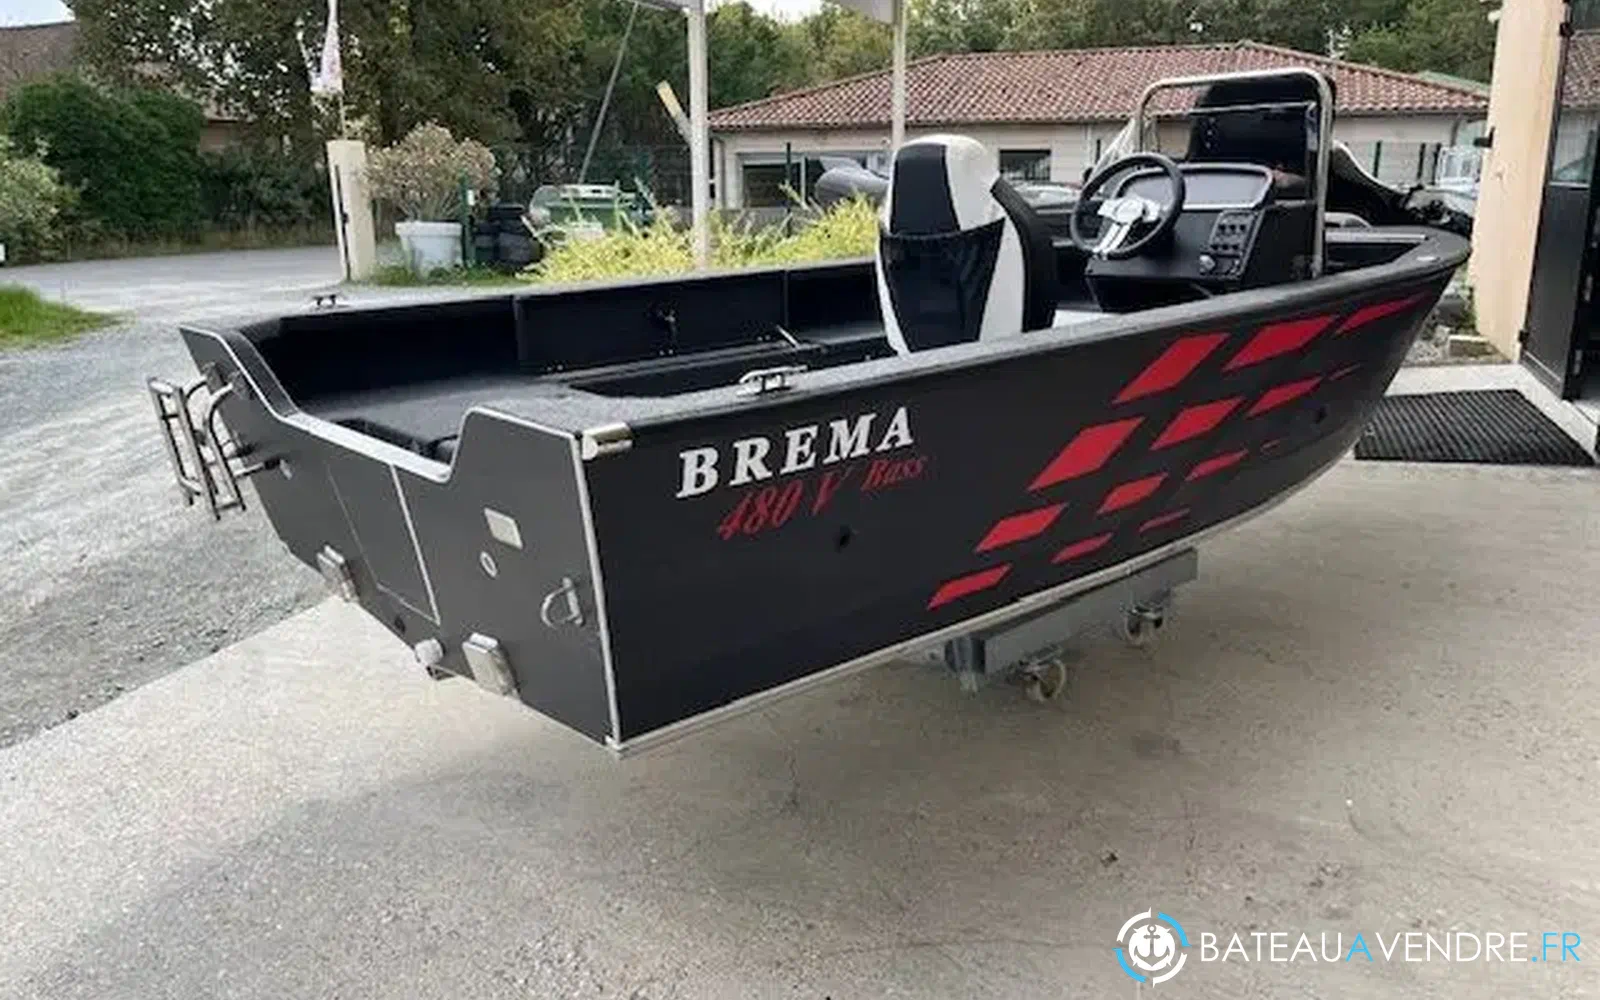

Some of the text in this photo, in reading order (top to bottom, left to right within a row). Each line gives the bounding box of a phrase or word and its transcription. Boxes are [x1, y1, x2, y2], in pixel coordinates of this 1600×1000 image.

[676, 406, 914, 498] BREMA
[717, 456, 928, 540] 480 V Bass
